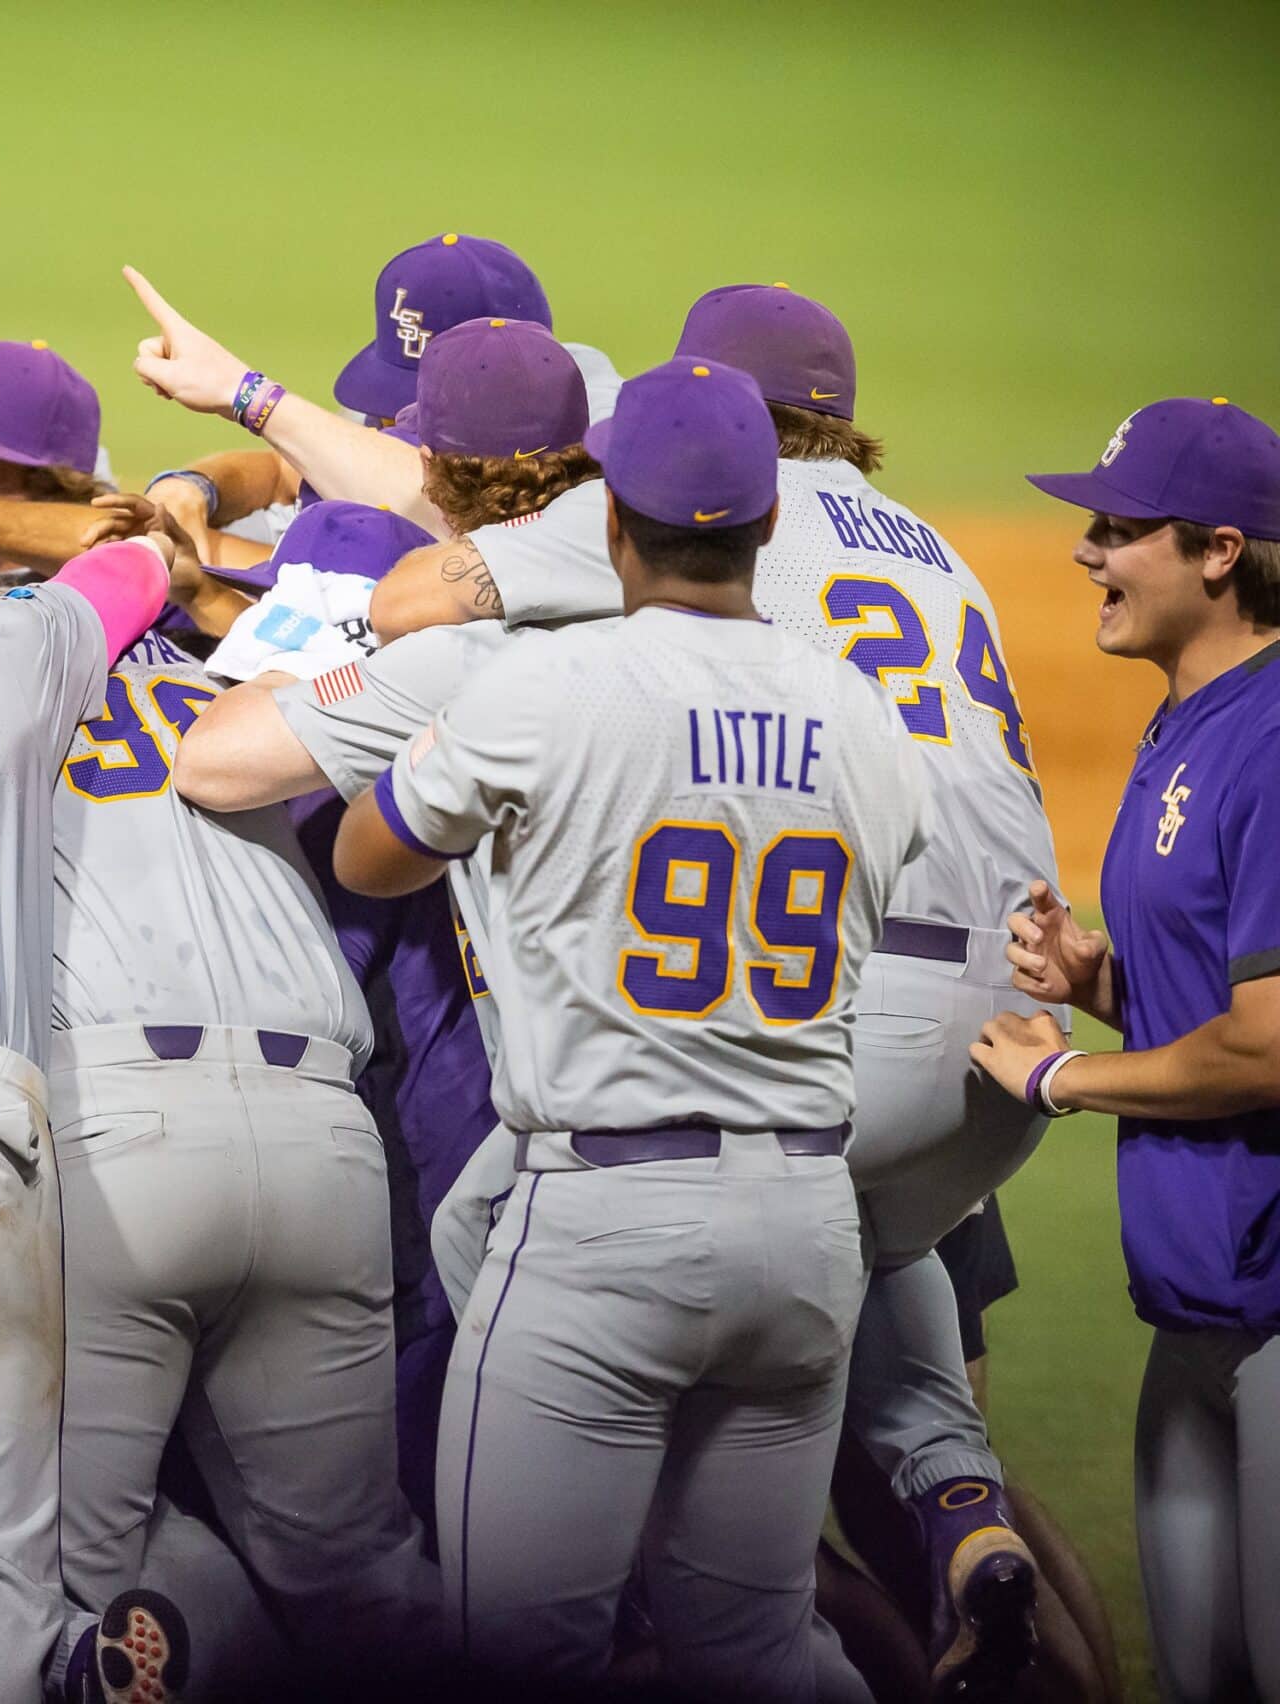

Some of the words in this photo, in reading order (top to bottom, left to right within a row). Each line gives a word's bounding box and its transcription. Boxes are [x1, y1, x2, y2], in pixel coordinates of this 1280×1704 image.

[389, 287, 433, 359] LSU
[816, 490, 953, 575] BELOSO
[818, 573, 1037, 780] 24
[688, 708, 823, 794] LITTLE
[1155, 762, 1193, 857] LSU
[616, 818, 855, 1028] 99
